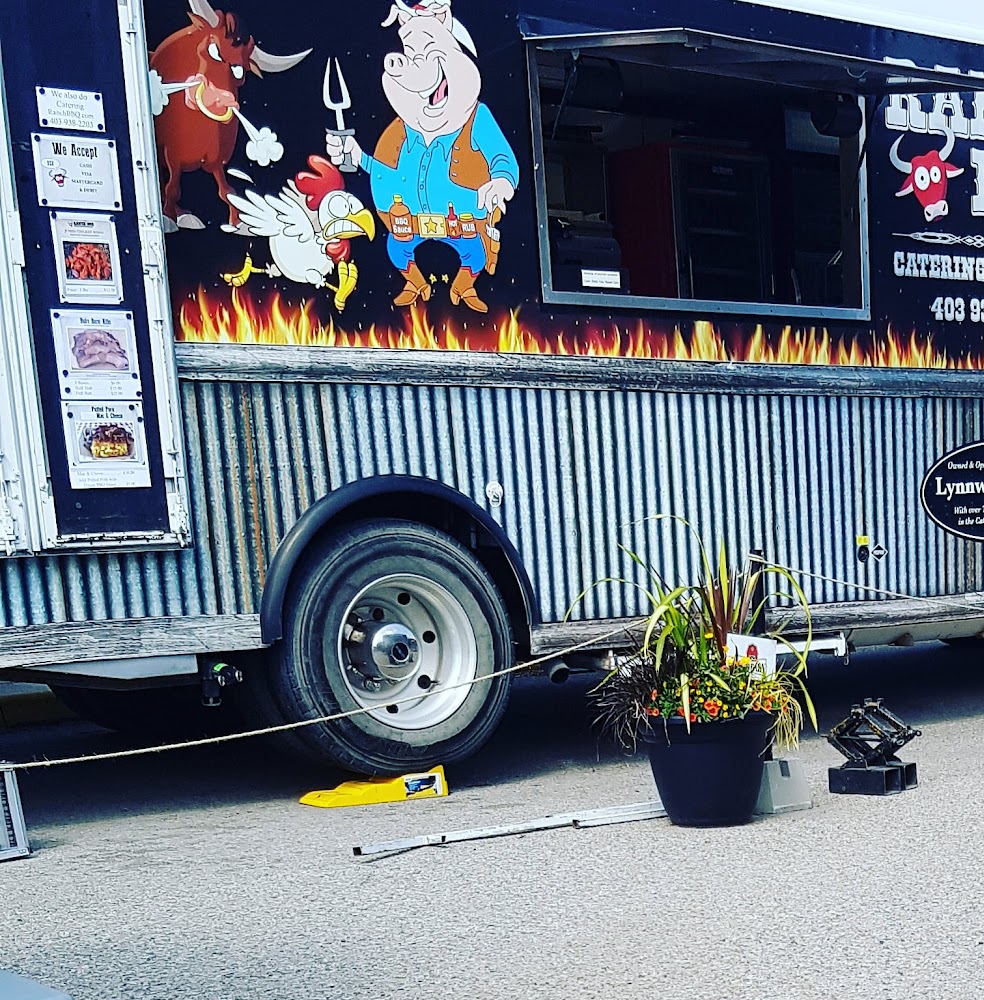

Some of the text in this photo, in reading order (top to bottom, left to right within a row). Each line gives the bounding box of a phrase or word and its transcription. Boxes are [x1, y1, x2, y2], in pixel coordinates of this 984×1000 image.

[51, 89, 62, 99] We
[51, 141, 98, 160] We Accept
[394, 217, 409, 225] BBQ
[461, 223, 476, 232] RUB
[930, 296, 966, 322] 403
[947, 460, 969, 470] Owned
[969, 460, 974, 470] &
[954, 505, 968, 515] With
[968, 506, 982, 514] over
[957, 517, 965, 526] in
[965, 516, 974, 525] the
